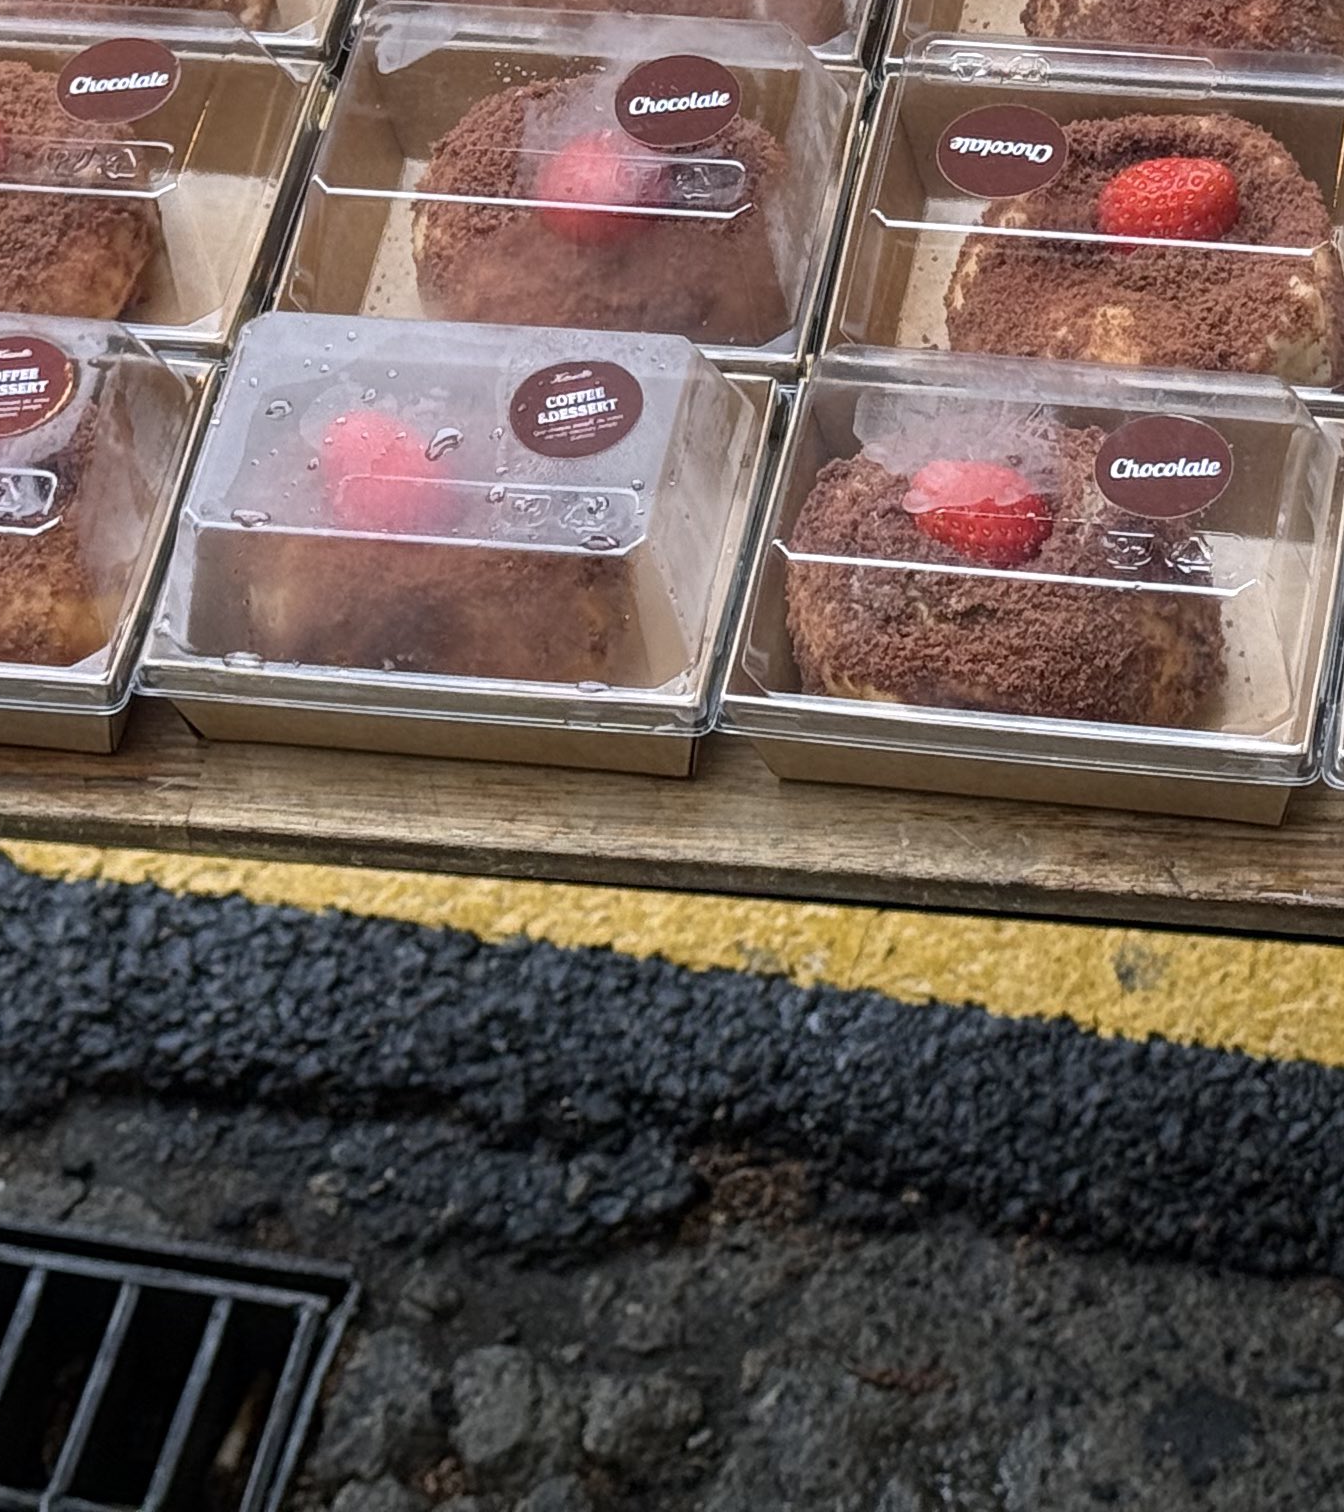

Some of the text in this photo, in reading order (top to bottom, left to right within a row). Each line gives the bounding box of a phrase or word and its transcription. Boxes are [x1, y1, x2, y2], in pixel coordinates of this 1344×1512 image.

[69, 72, 169, 94] Chocolate
[629, 91, 731, 115] Chocolate
[950, 136, 1053, 163] Chocolate
[546, 387, 605, 408] COFFEE
[538, 398, 618, 424] &DESSERT
[1110, 458, 1221, 478] Chocolate
